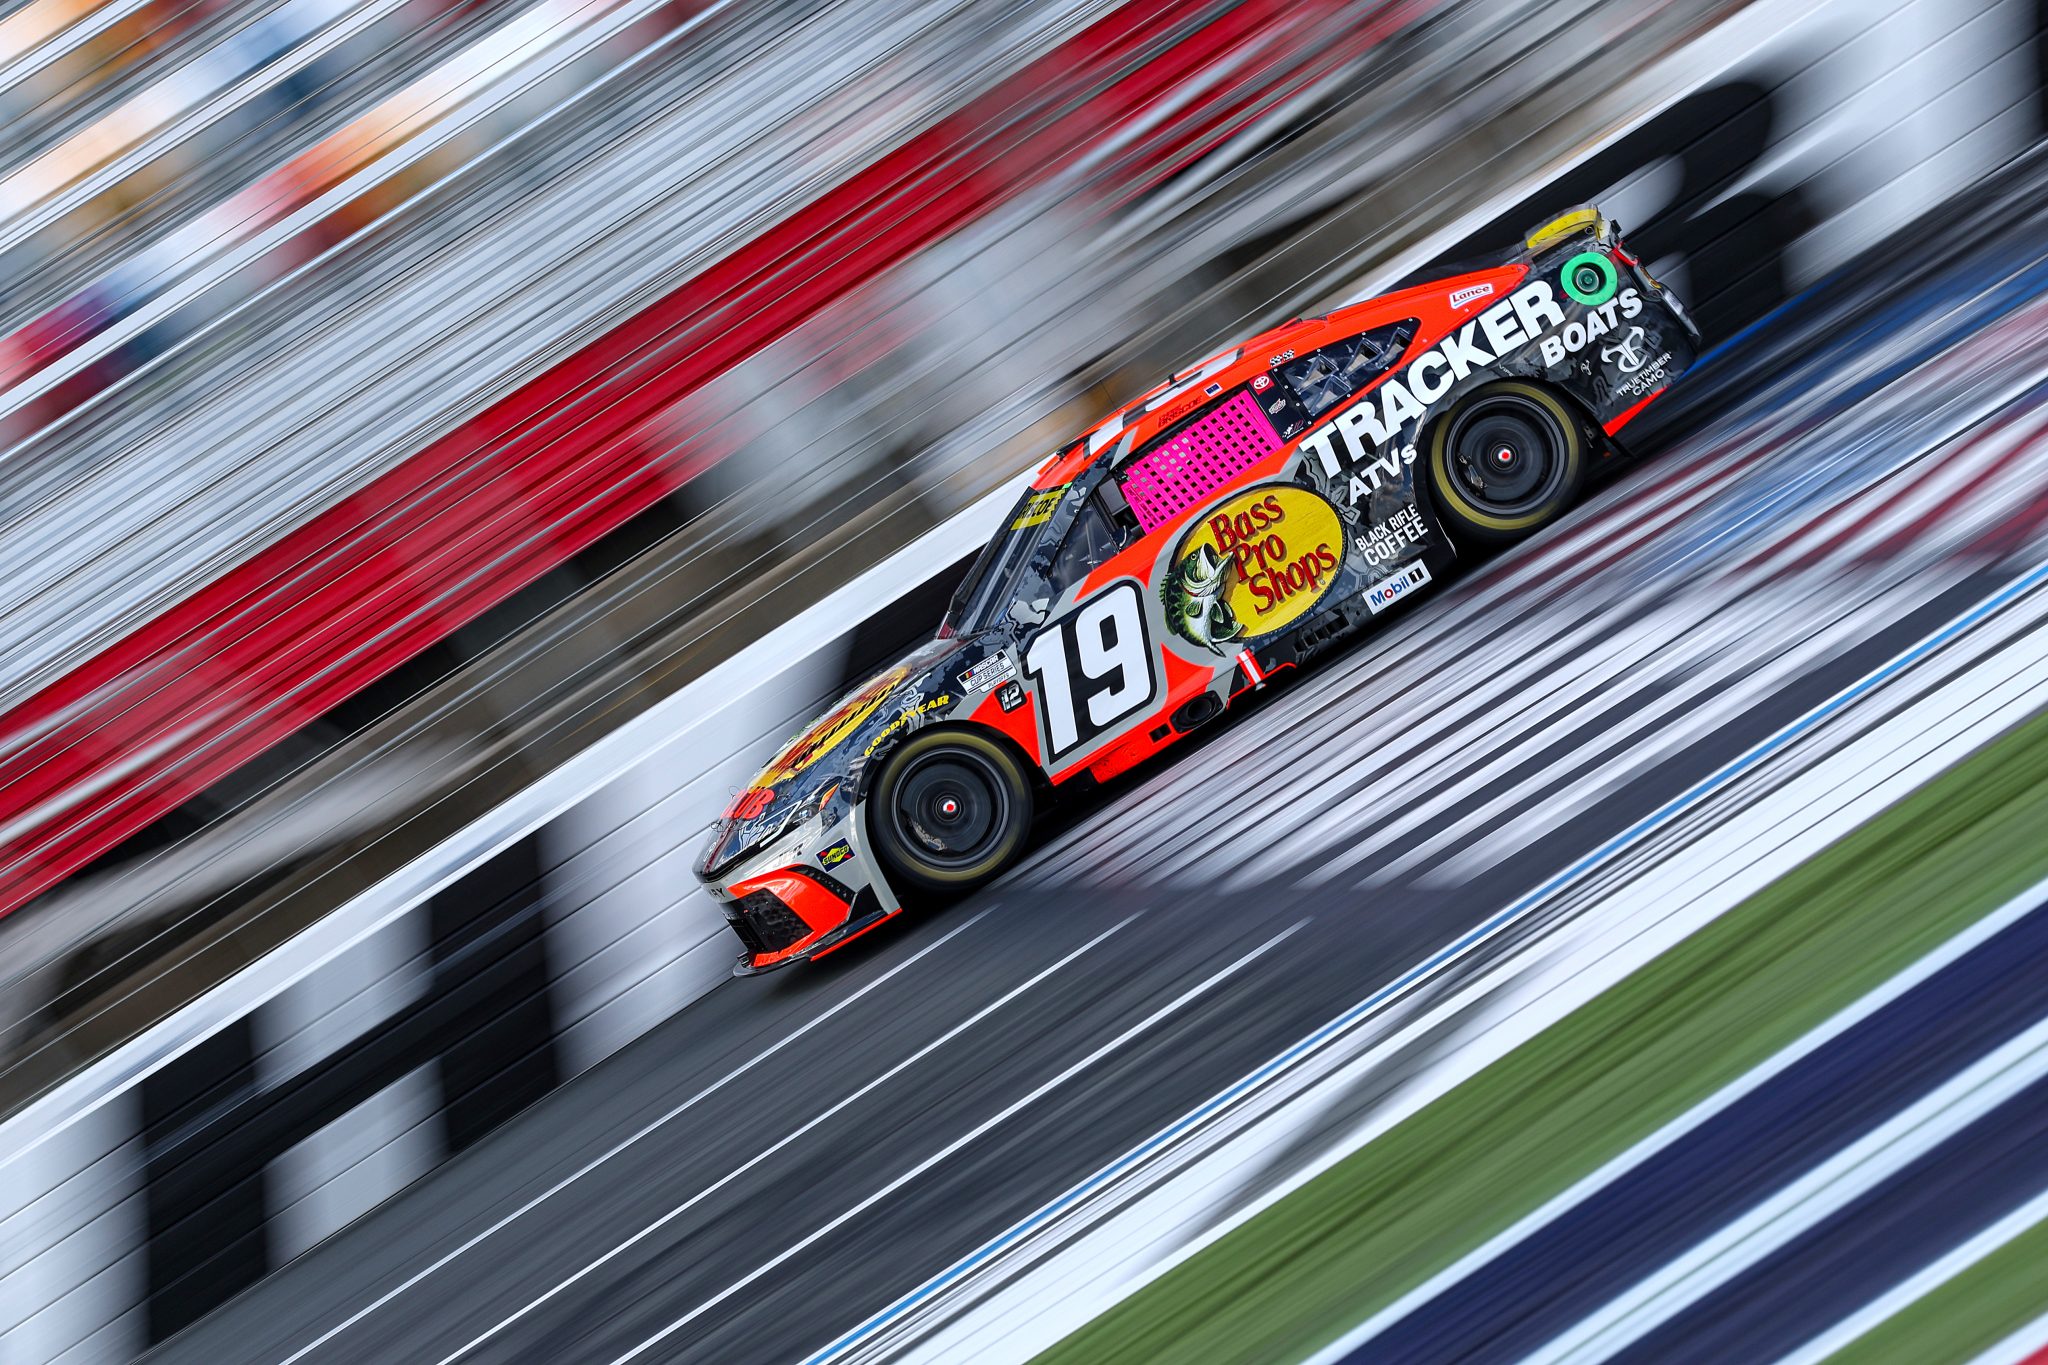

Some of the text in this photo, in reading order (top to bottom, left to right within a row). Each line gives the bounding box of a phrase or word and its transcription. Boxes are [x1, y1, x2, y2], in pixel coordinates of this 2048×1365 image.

[1452, 286, 1490, 303] Lance
[1540, 287, 1643, 369] BOATS
[1300, 280, 1566, 479] TRACKER
[1616, 352, 1672, 396] TRUETIMBER
[1632, 369, 1665, 396] CAMO
[1348, 443, 1418, 506] ATVs
[1208, 495, 1284, 554] Bass
[1355, 503, 1419, 552] BLACK RIFLE
[1363, 516, 1429, 566] COFFEE
[1232, 534, 1285, 583] Pro
[1248, 543, 1337, 615] Shops
[1370, 576, 1410, 607] Mobil
[970, 662, 1005, 687] CUP SERIES
[974, 655, 999, 674] NASCAR
[1026, 585, 1151, 754] 19
[1001, 683, 1022, 711] 12
[864, 694, 950, 757] GOODYEAR
[821, 844, 850, 866] SUNOCO
